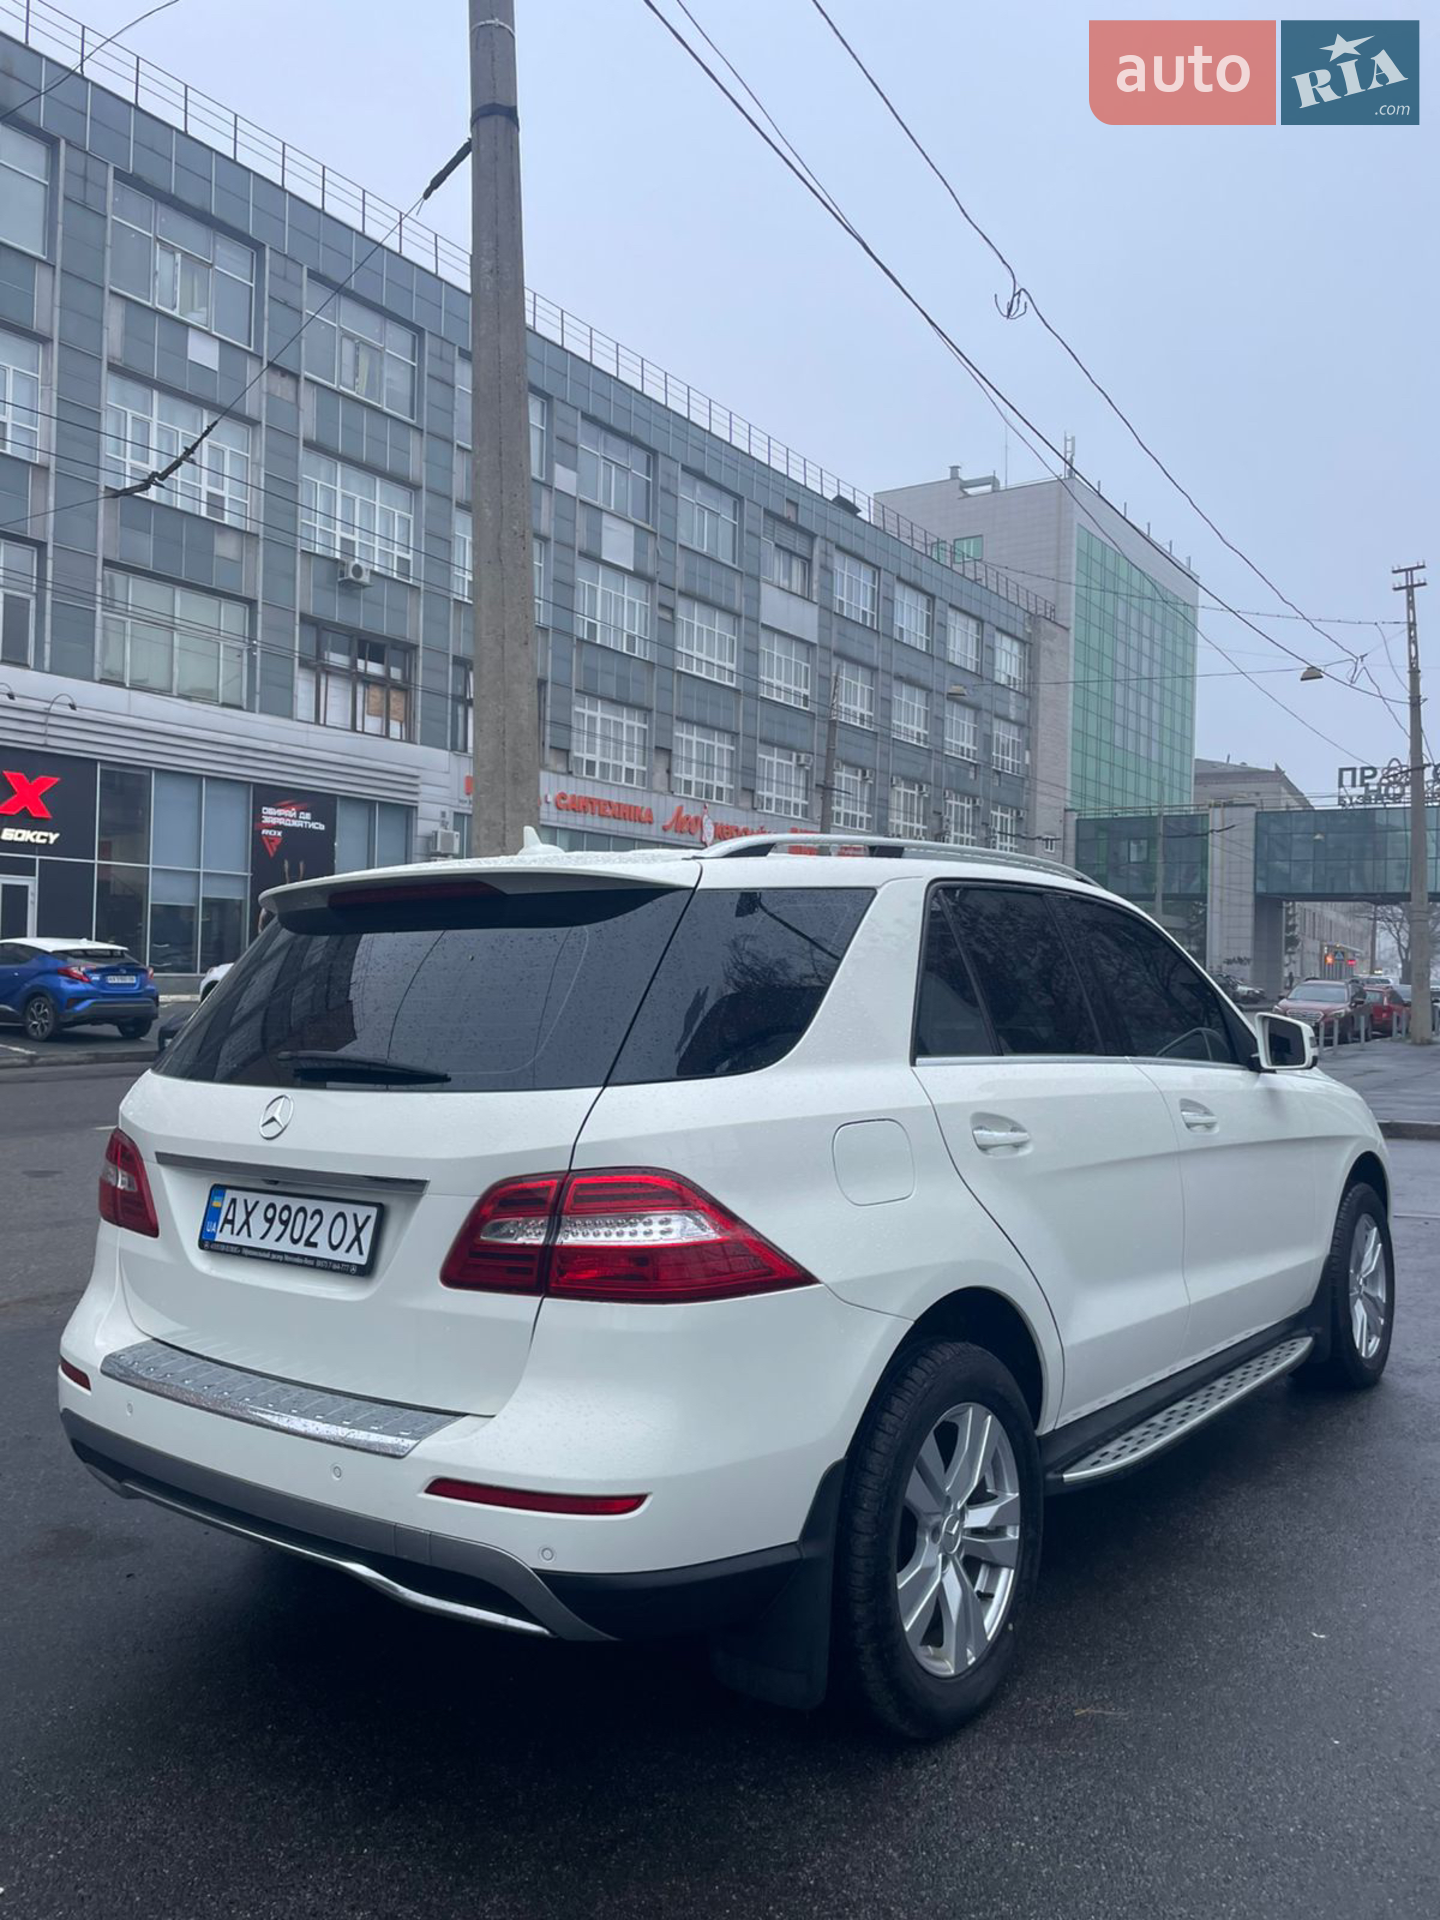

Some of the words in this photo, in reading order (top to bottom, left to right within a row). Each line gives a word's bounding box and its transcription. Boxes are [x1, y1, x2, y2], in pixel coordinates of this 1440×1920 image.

[556, 791, 653, 824] САНТЕХНІКА
[0, 827, 60, 844] БОКСУ
[206, 1221, 217, 1233] UA
[219, 1197, 260, 1238] AX
[260, 1202, 324, 1248] 9902
[328, 1211, 371, 1256] OX
